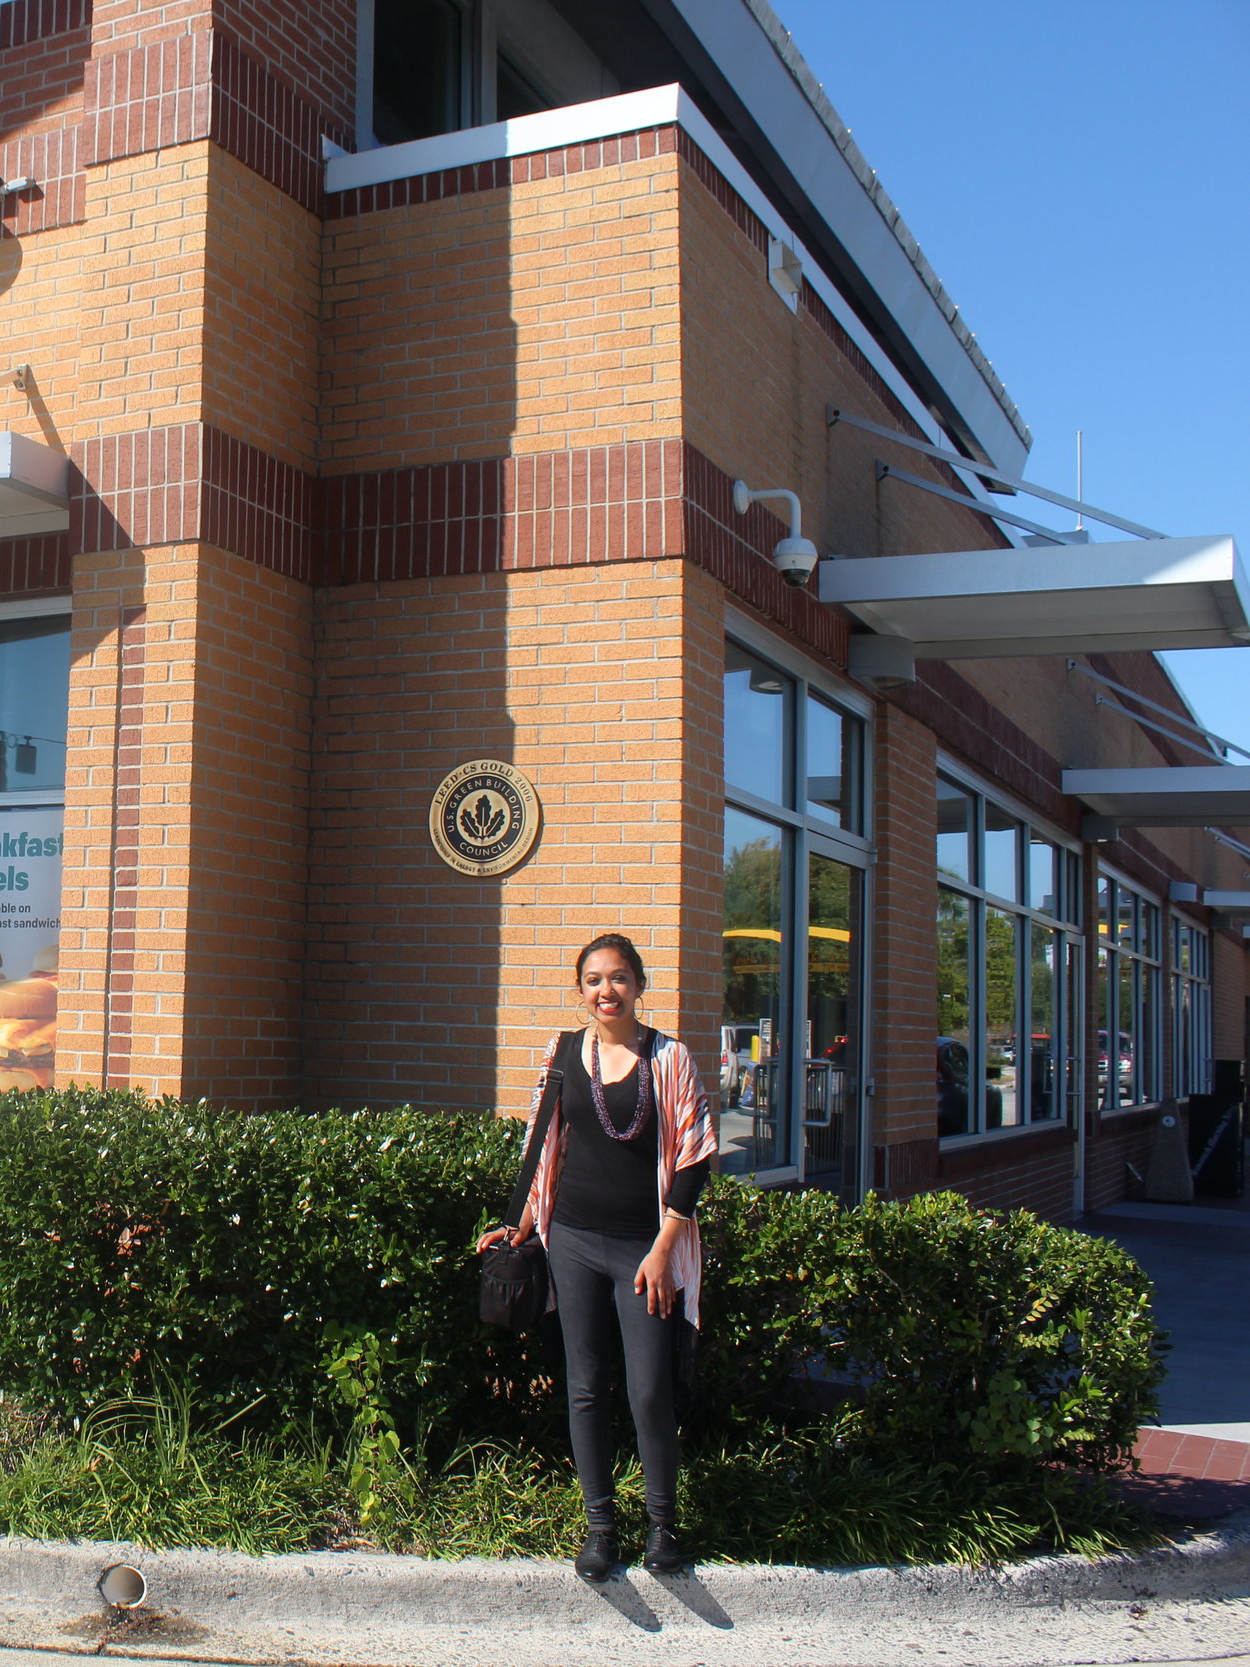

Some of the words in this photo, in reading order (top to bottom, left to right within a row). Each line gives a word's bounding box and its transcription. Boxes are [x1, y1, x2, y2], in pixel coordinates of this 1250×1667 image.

[435, 763, 477, 806] LEED-CS
[480, 761, 514, 778] GOLD
[515, 777, 533, 803] 2006
[449, 779, 483, 809] GREEN
[485, 778, 521, 830] BUILDING
[459, 841, 509, 856] COUNCIL
[18, 905, 31, 914] on
[13, 917, 62, 929] sandwich
